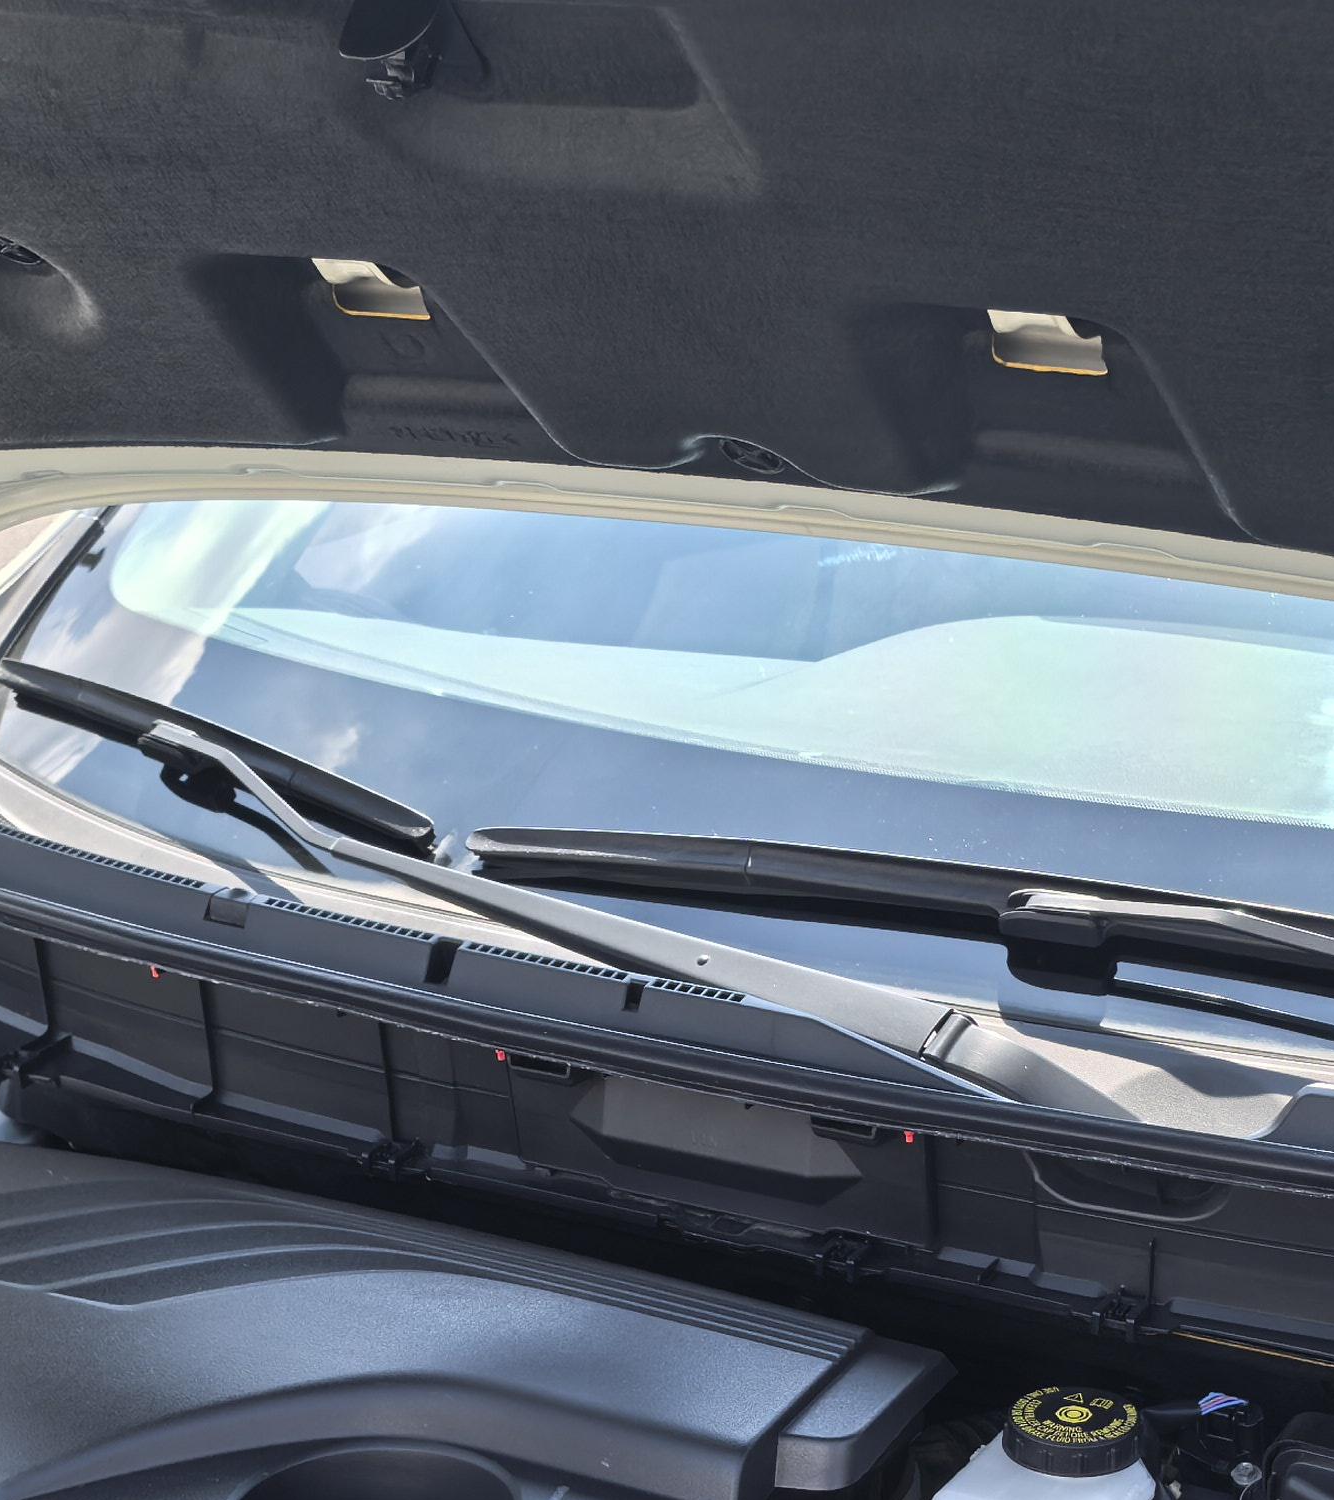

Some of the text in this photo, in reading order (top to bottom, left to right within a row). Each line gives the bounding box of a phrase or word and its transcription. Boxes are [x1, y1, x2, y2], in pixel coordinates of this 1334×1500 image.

[1042, 1419, 1083, 1432] WARNING
[1046, 1434, 1071, 1444] FLUID
[1052, 1430, 1092, 1438] BEFORE
